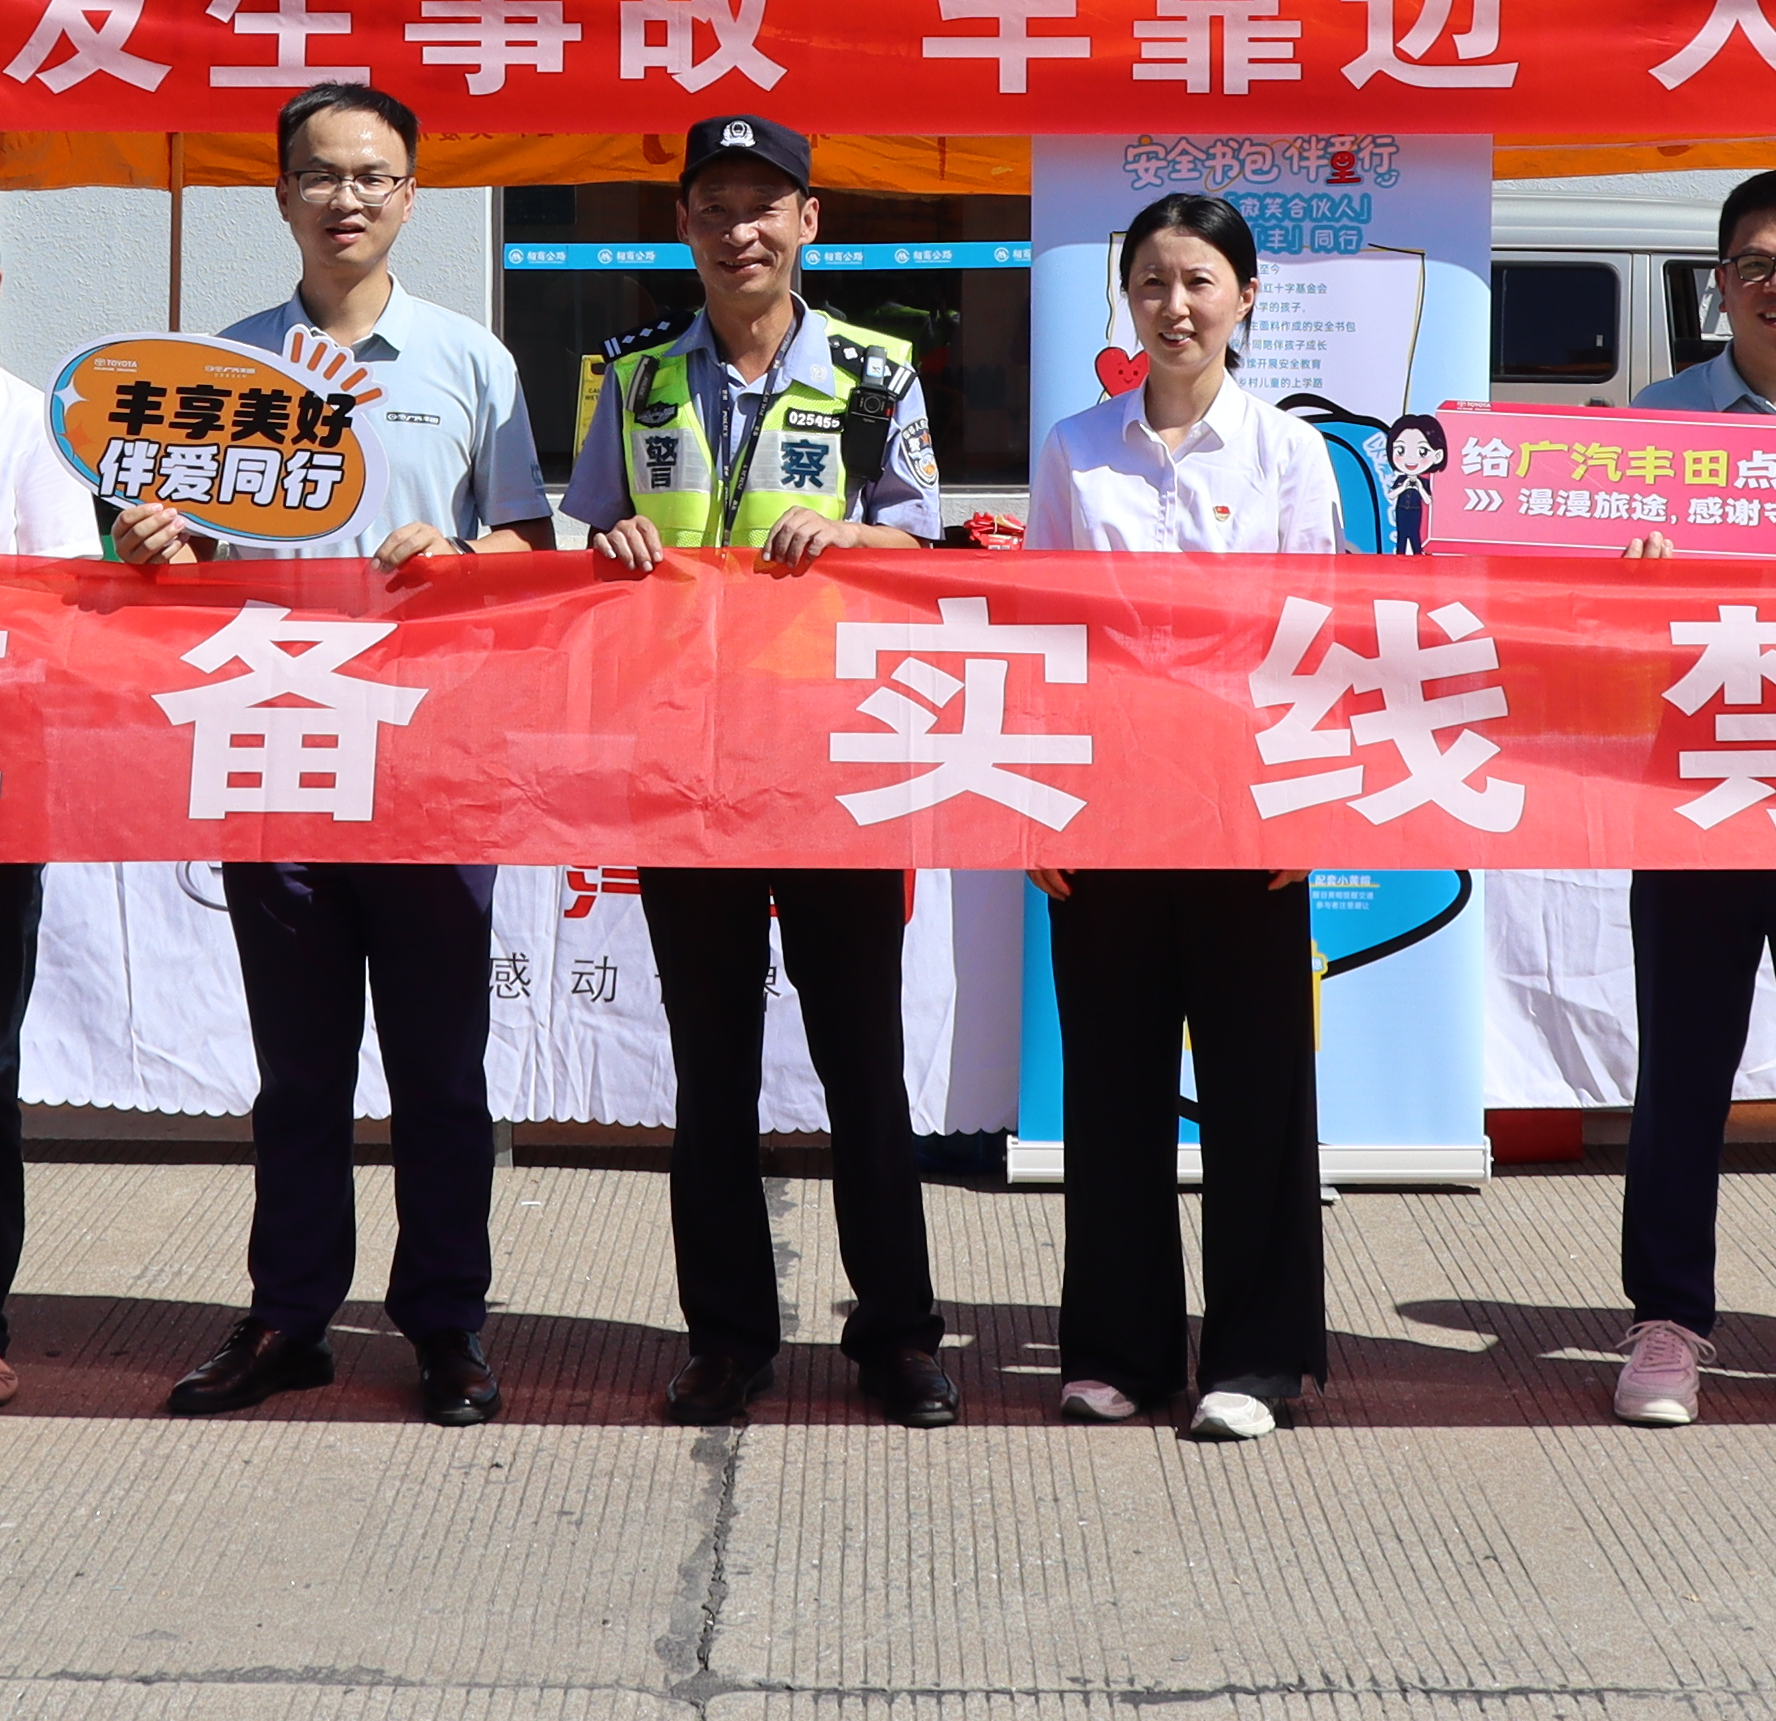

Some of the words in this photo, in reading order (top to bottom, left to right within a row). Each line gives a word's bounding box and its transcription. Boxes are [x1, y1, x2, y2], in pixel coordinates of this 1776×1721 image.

[1124, 135, 1280, 190] 安全书包
[109, 381, 356, 448] 丰享美好
[100, 439, 344, 510] 伴爱同行
[645, 436, 678, 489] 警
[780, 439, 830, 488] 察
